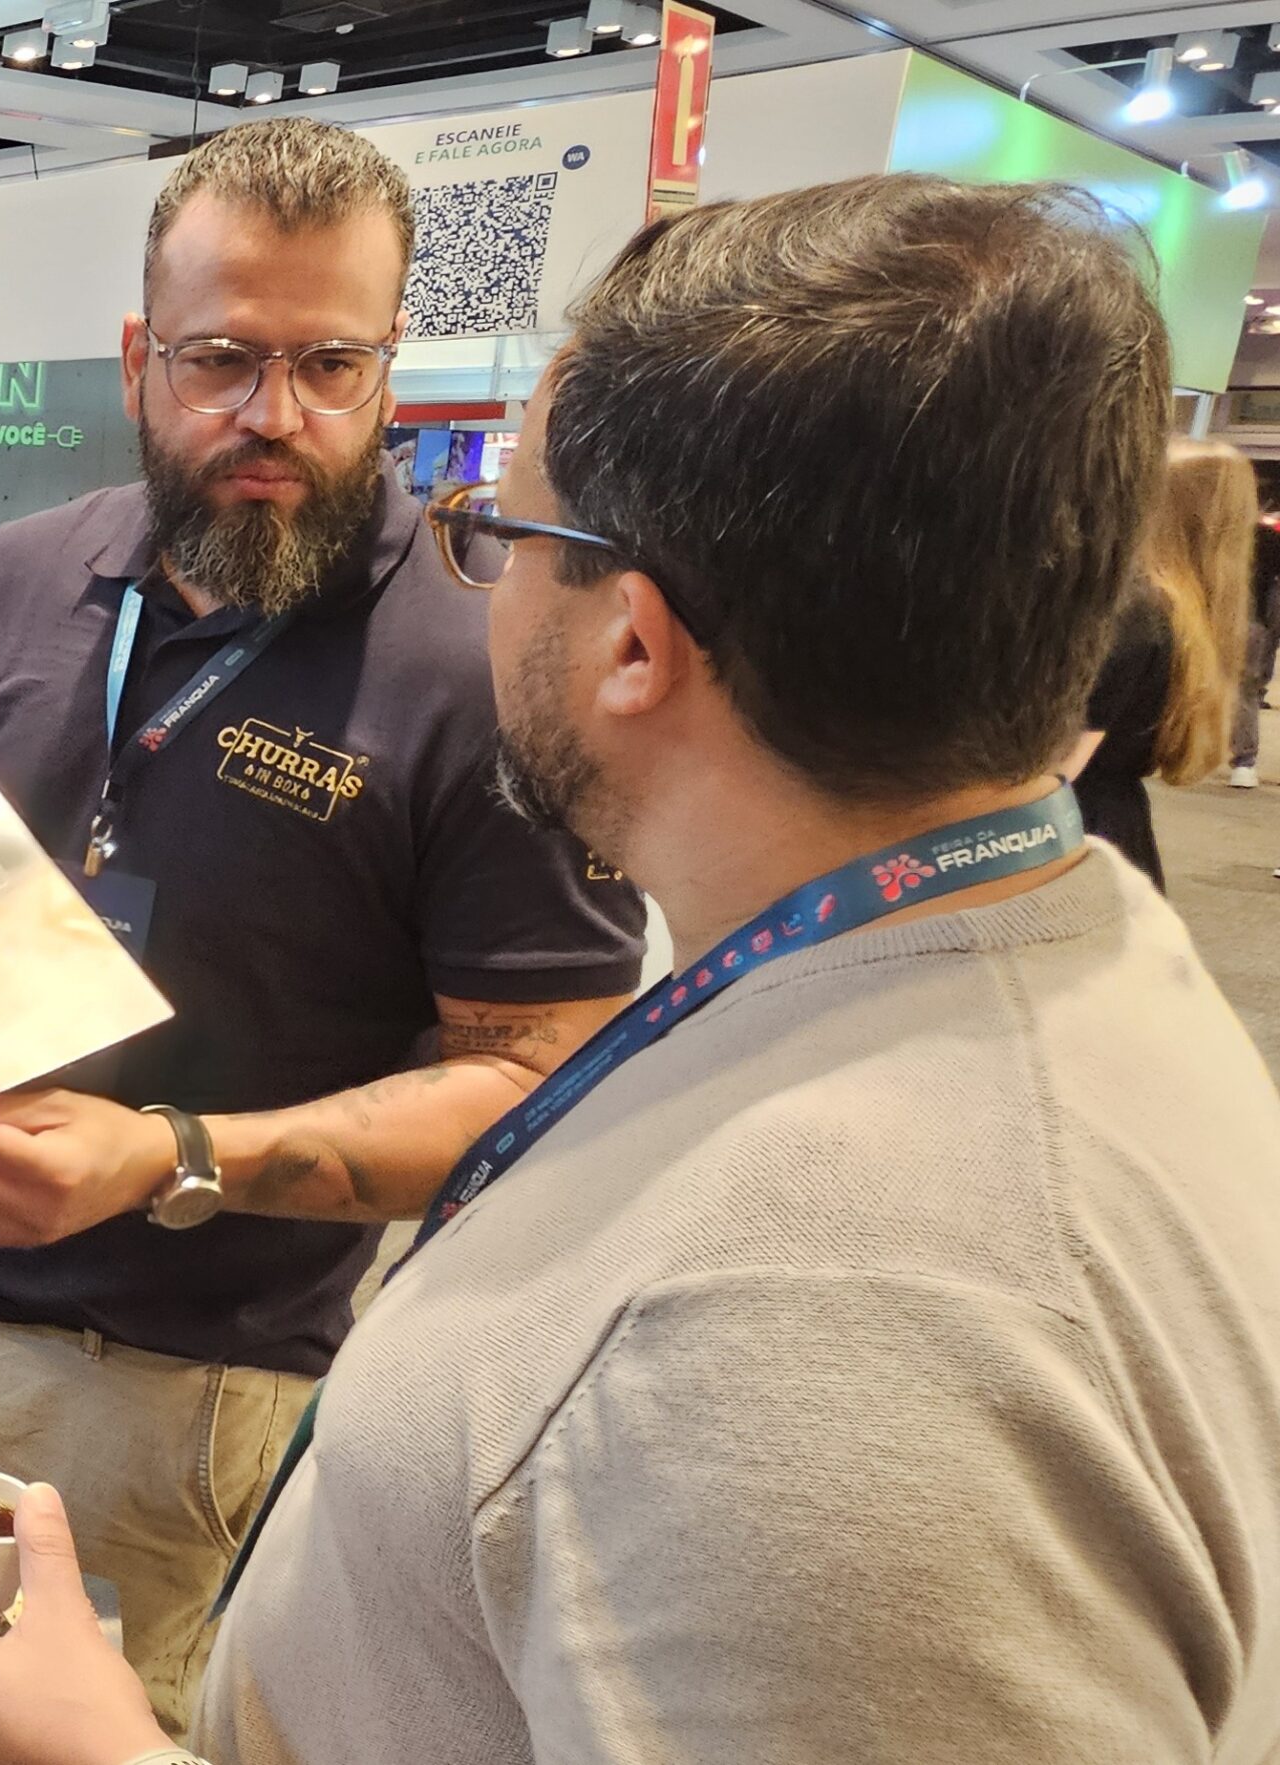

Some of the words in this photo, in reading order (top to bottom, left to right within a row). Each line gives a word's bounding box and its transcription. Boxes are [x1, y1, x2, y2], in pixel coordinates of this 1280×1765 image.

[415, 151, 426, 165] E
[428, 145, 472, 163] FALE
[477, 136, 543, 156] AGORA
[436, 124, 522, 146] ESCANEIE
[163, 674, 220, 728] FRANQUIA
[217, 726, 363, 798] CHURRAS
[255, 767, 271, 784] IN
[273, 775, 303, 797] BOX
[936, 823, 1057, 873] FRANQUIA
